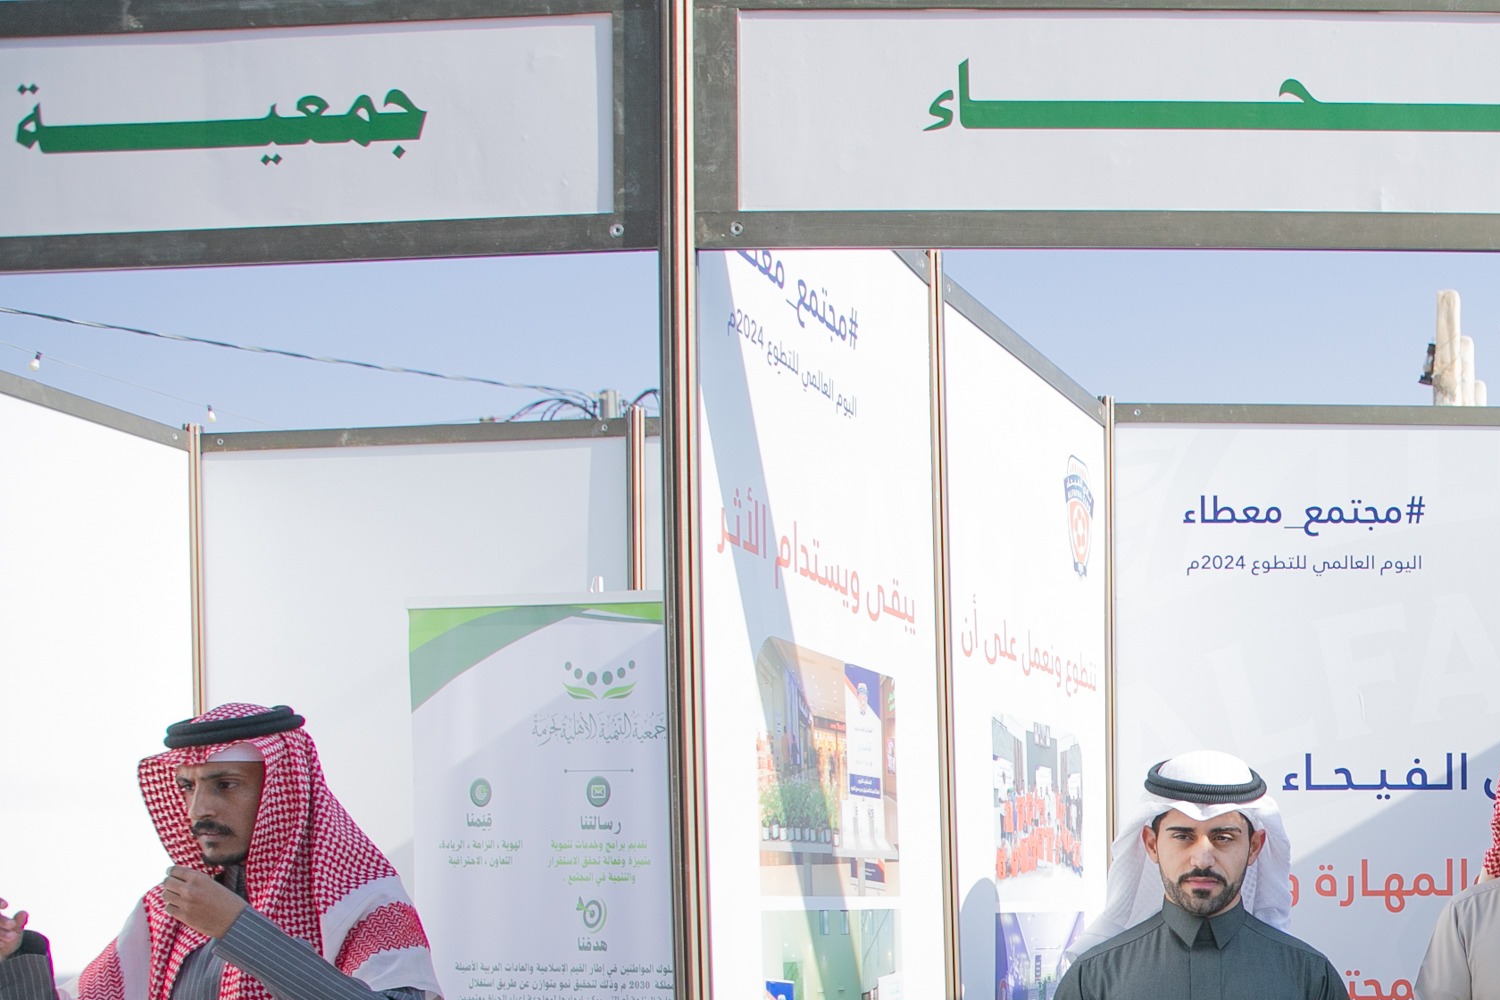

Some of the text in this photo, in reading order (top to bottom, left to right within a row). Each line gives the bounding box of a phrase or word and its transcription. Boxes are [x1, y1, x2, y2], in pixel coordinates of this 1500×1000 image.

[16, 84, 427, 165] جمعية
[767, 341, 799, 375] للتطوع
[801, 369, 834, 402] العالمي
[836, 393, 858, 419] اليوم
[1183, 494, 1426, 536] #مجتمع_معطاء
[717, 486, 916, 636] يبقى ويستدام الأثر
[1186, 555, 1423, 577] اليوم العالمي للتطوع 2024م
[961, 593, 978, 657] أن
[984, 619, 1017, 665] على
[1022, 629, 1061, 688] ونعمل
[1282, 752, 1468, 800] الفيحاء
[580, 815, 622, 835] رسالتنا
[1315, 858, 1481, 913] المهارة
[577, 936, 608, 952] هدفنا
[629, 980, 651, 990] 2030
